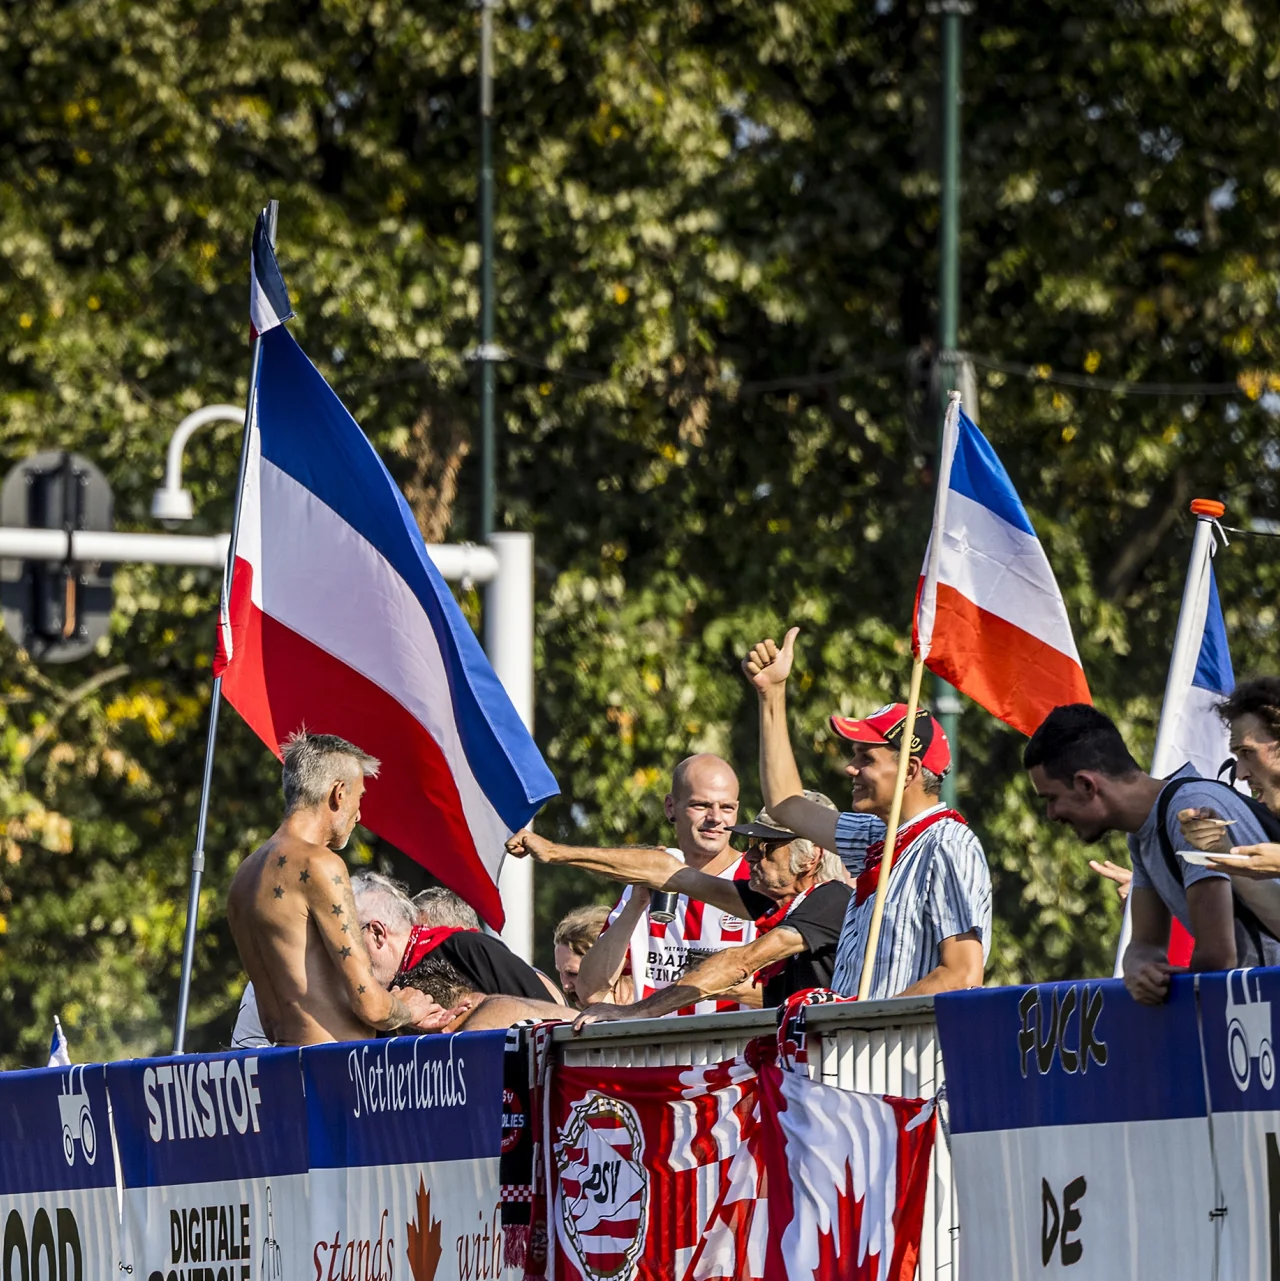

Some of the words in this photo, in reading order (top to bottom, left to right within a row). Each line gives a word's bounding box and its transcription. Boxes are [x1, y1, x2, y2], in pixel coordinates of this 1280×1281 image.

[1017, 982, 1108, 1079] FUCK
[143, 1057, 261, 1142] STIKSTOF
[348, 1033, 468, 1118] Netherlands
[583, 1160, 622, 1204] PSV
[1041, 1174, 1088, 1268] DE
[170, 1203, 251, 1264] DIGITALE
